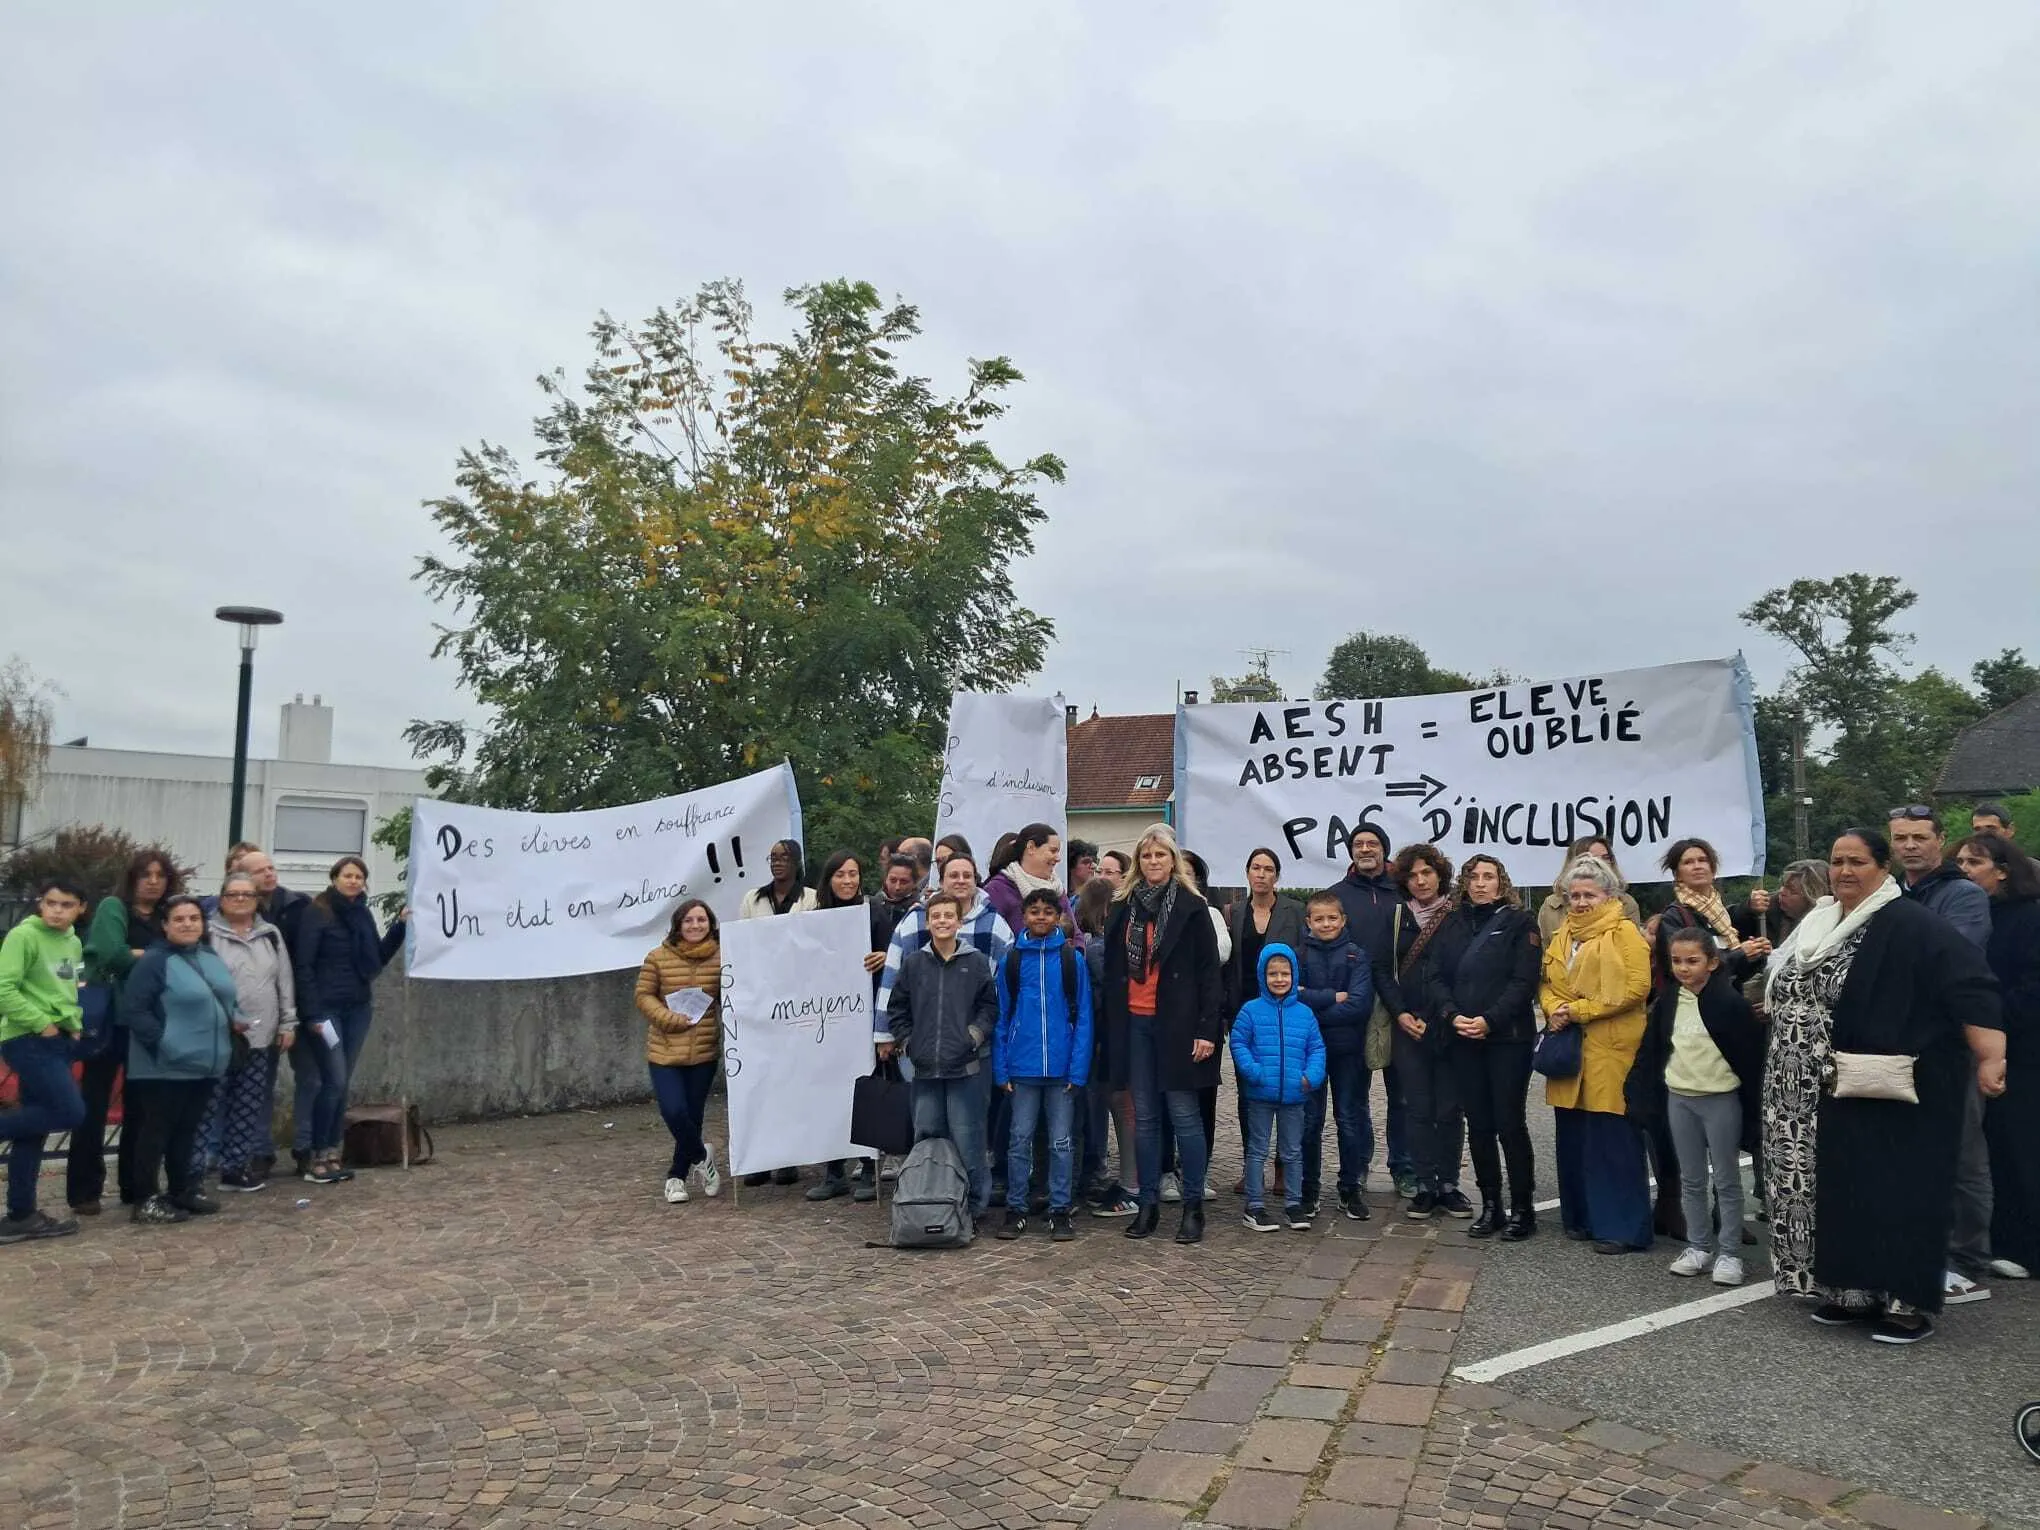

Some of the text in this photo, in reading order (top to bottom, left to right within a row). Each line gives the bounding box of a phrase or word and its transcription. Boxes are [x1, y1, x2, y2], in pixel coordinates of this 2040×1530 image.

[1249, 702, 1383, 744] AESH
[1469, 678, 1607, 724] ELEVE
[940, 736, 960, 818] PAS
[985, 767, 1056, 795] d'inclusion
[1238, 744, 1395, 787] ABSENT
[437, 803, 736, 861] Des élèves en souffrance
[436, 888, 485, 938] Un
[506, 899, 553, 928] état
[568, 900, 595, 918] en
[617, 878, 690, 908] silence
[720, 964, 742, 1078] SANS
[771, 994, 864, 1044] moyens
